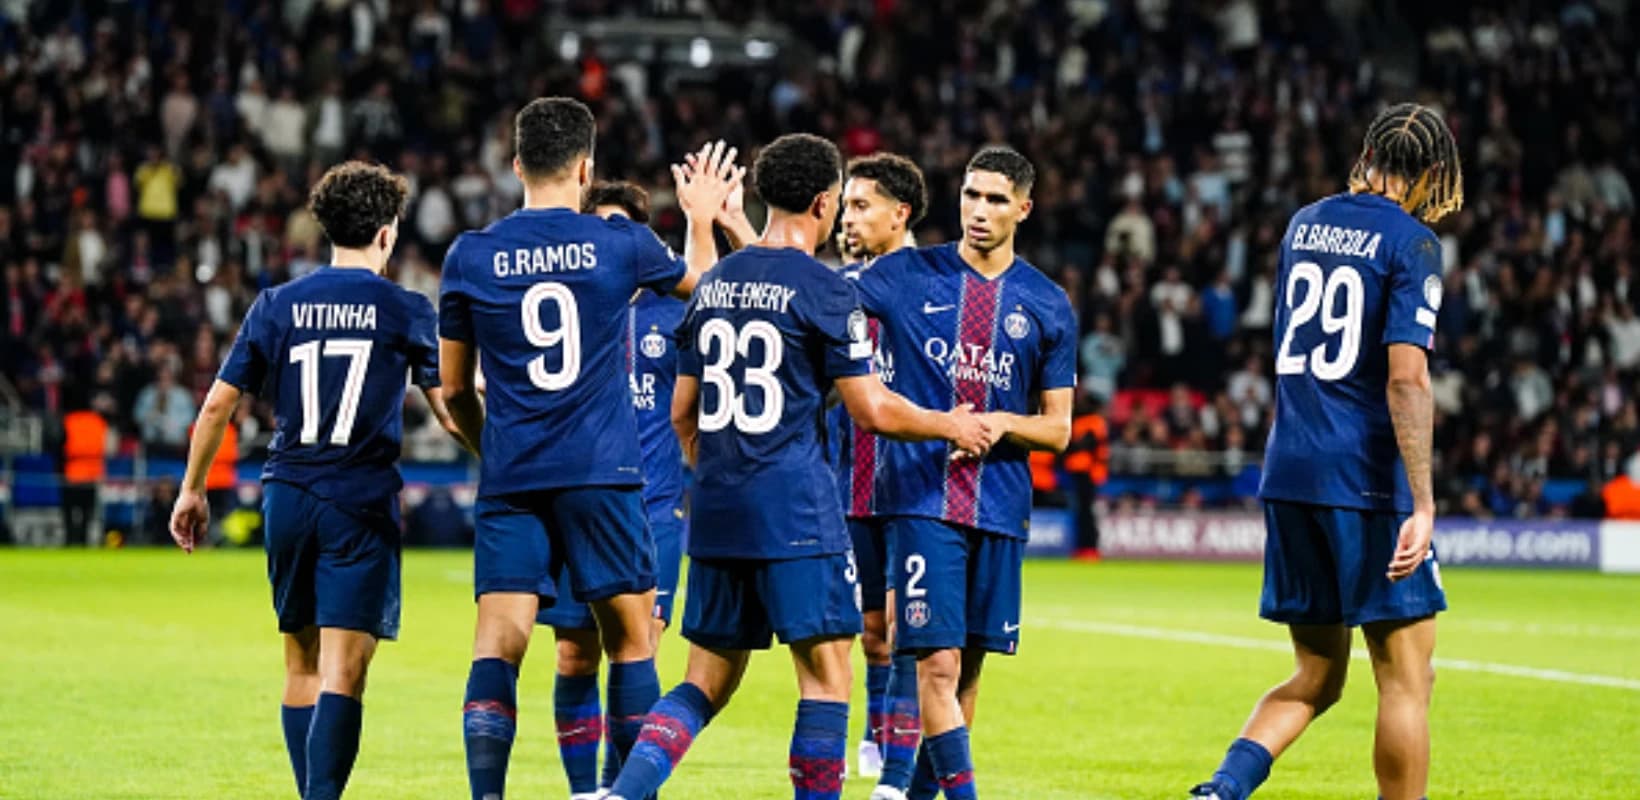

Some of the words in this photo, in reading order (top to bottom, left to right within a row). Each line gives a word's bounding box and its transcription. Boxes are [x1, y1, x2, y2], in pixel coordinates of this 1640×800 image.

[493, 242, 598, 278] G.RAMOS
[1292, 223, 1382, 260] B.BARCOLA
[292, 303, 377, 330] VITINHA
[521, 281, 581, 391] 9
[1275, 261, 1365, 382] 29
[698, 317, 785, 435] 33
[924, 337, 1014, 376] QATAR
[289, 338, 374, 445] 17
[947, 364, 1012, 391] AIRWAYS
[905, 554, 927, 597] 2
